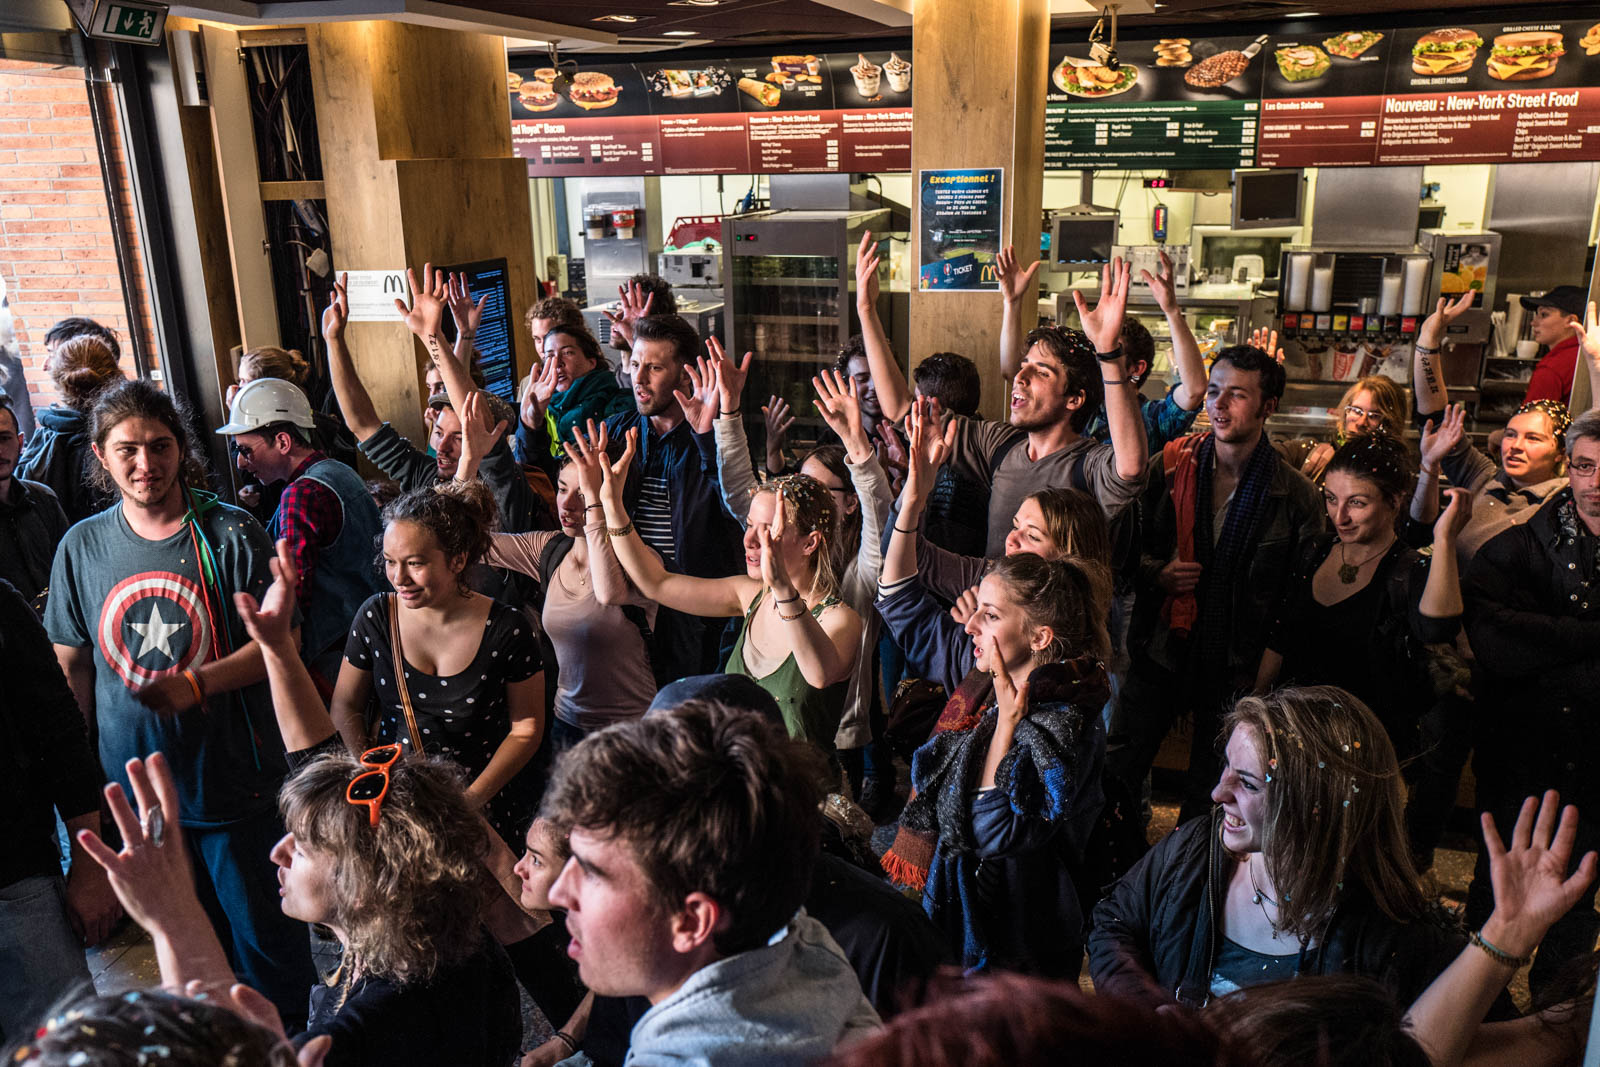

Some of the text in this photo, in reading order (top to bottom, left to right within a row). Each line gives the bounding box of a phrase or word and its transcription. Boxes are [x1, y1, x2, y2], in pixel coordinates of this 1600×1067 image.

[1410, 78, 1430, 86] ORIGINAL
[1446, 76, 1468, 84] MUSTARD
[1276, 102, 1300, 110] Grandes
[1300, 101, 1324, 109] Salades
[1386, 91, 1580, 113] Nouveau : New-York Street Food
[544, 123, 565, 133] Bacon
[1517, 120, 1534, 128] Original
[930, 174, 989, 184] Exceptionnel
[953, 264, 973, 275] TICKET
